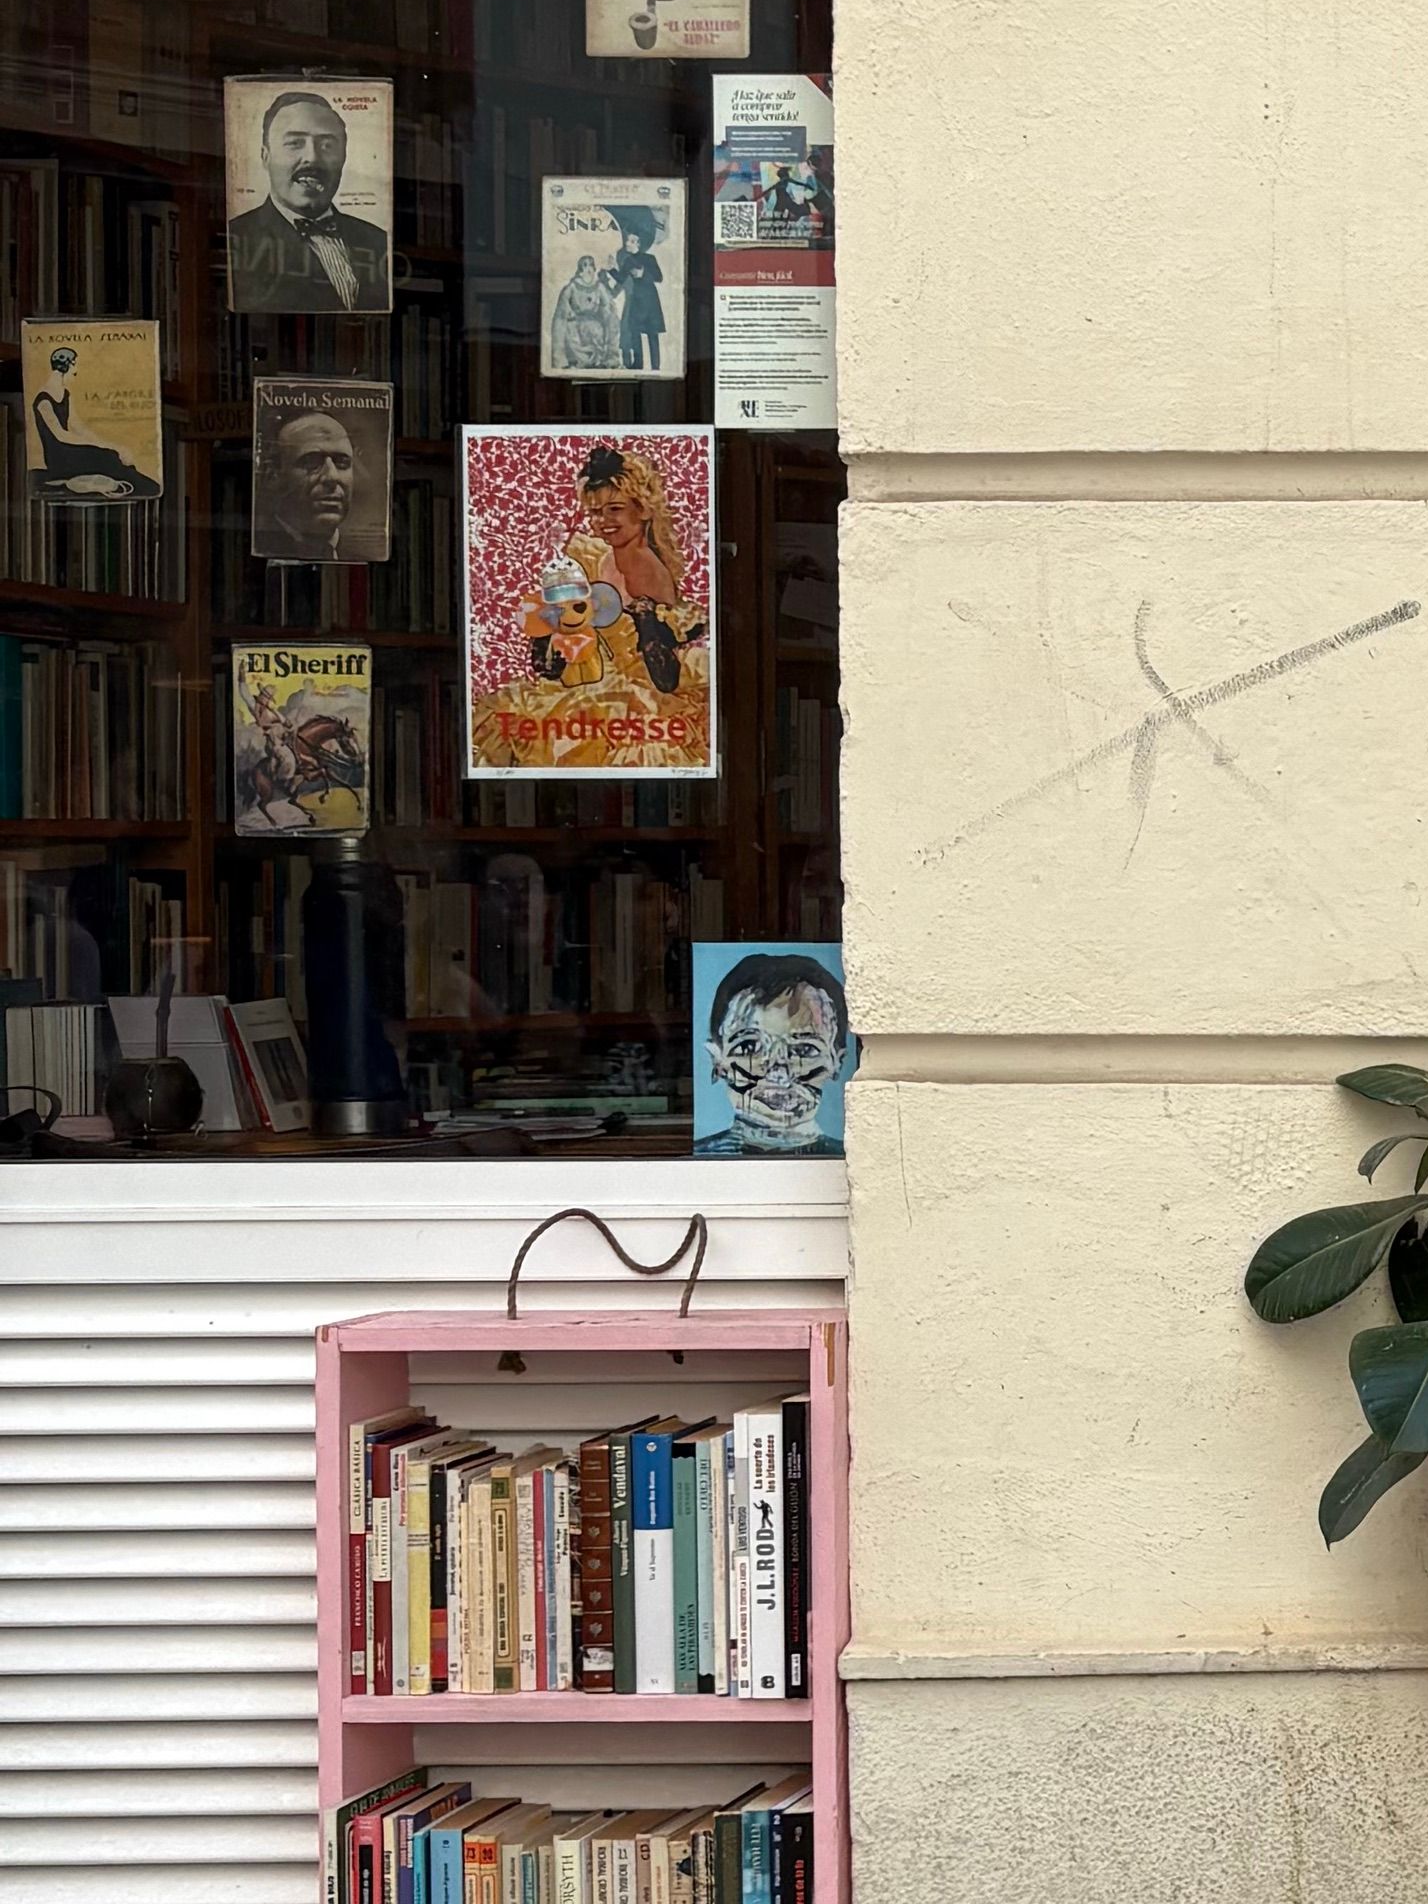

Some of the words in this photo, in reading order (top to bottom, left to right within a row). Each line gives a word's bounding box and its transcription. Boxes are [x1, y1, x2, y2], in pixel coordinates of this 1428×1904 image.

[247, 650, 270, 675] El
[273, 650, 367, 679] Sheriff
[498, 711, 687, 745] Tendresse
[612, 1444, 628, 1509] Vendaval
